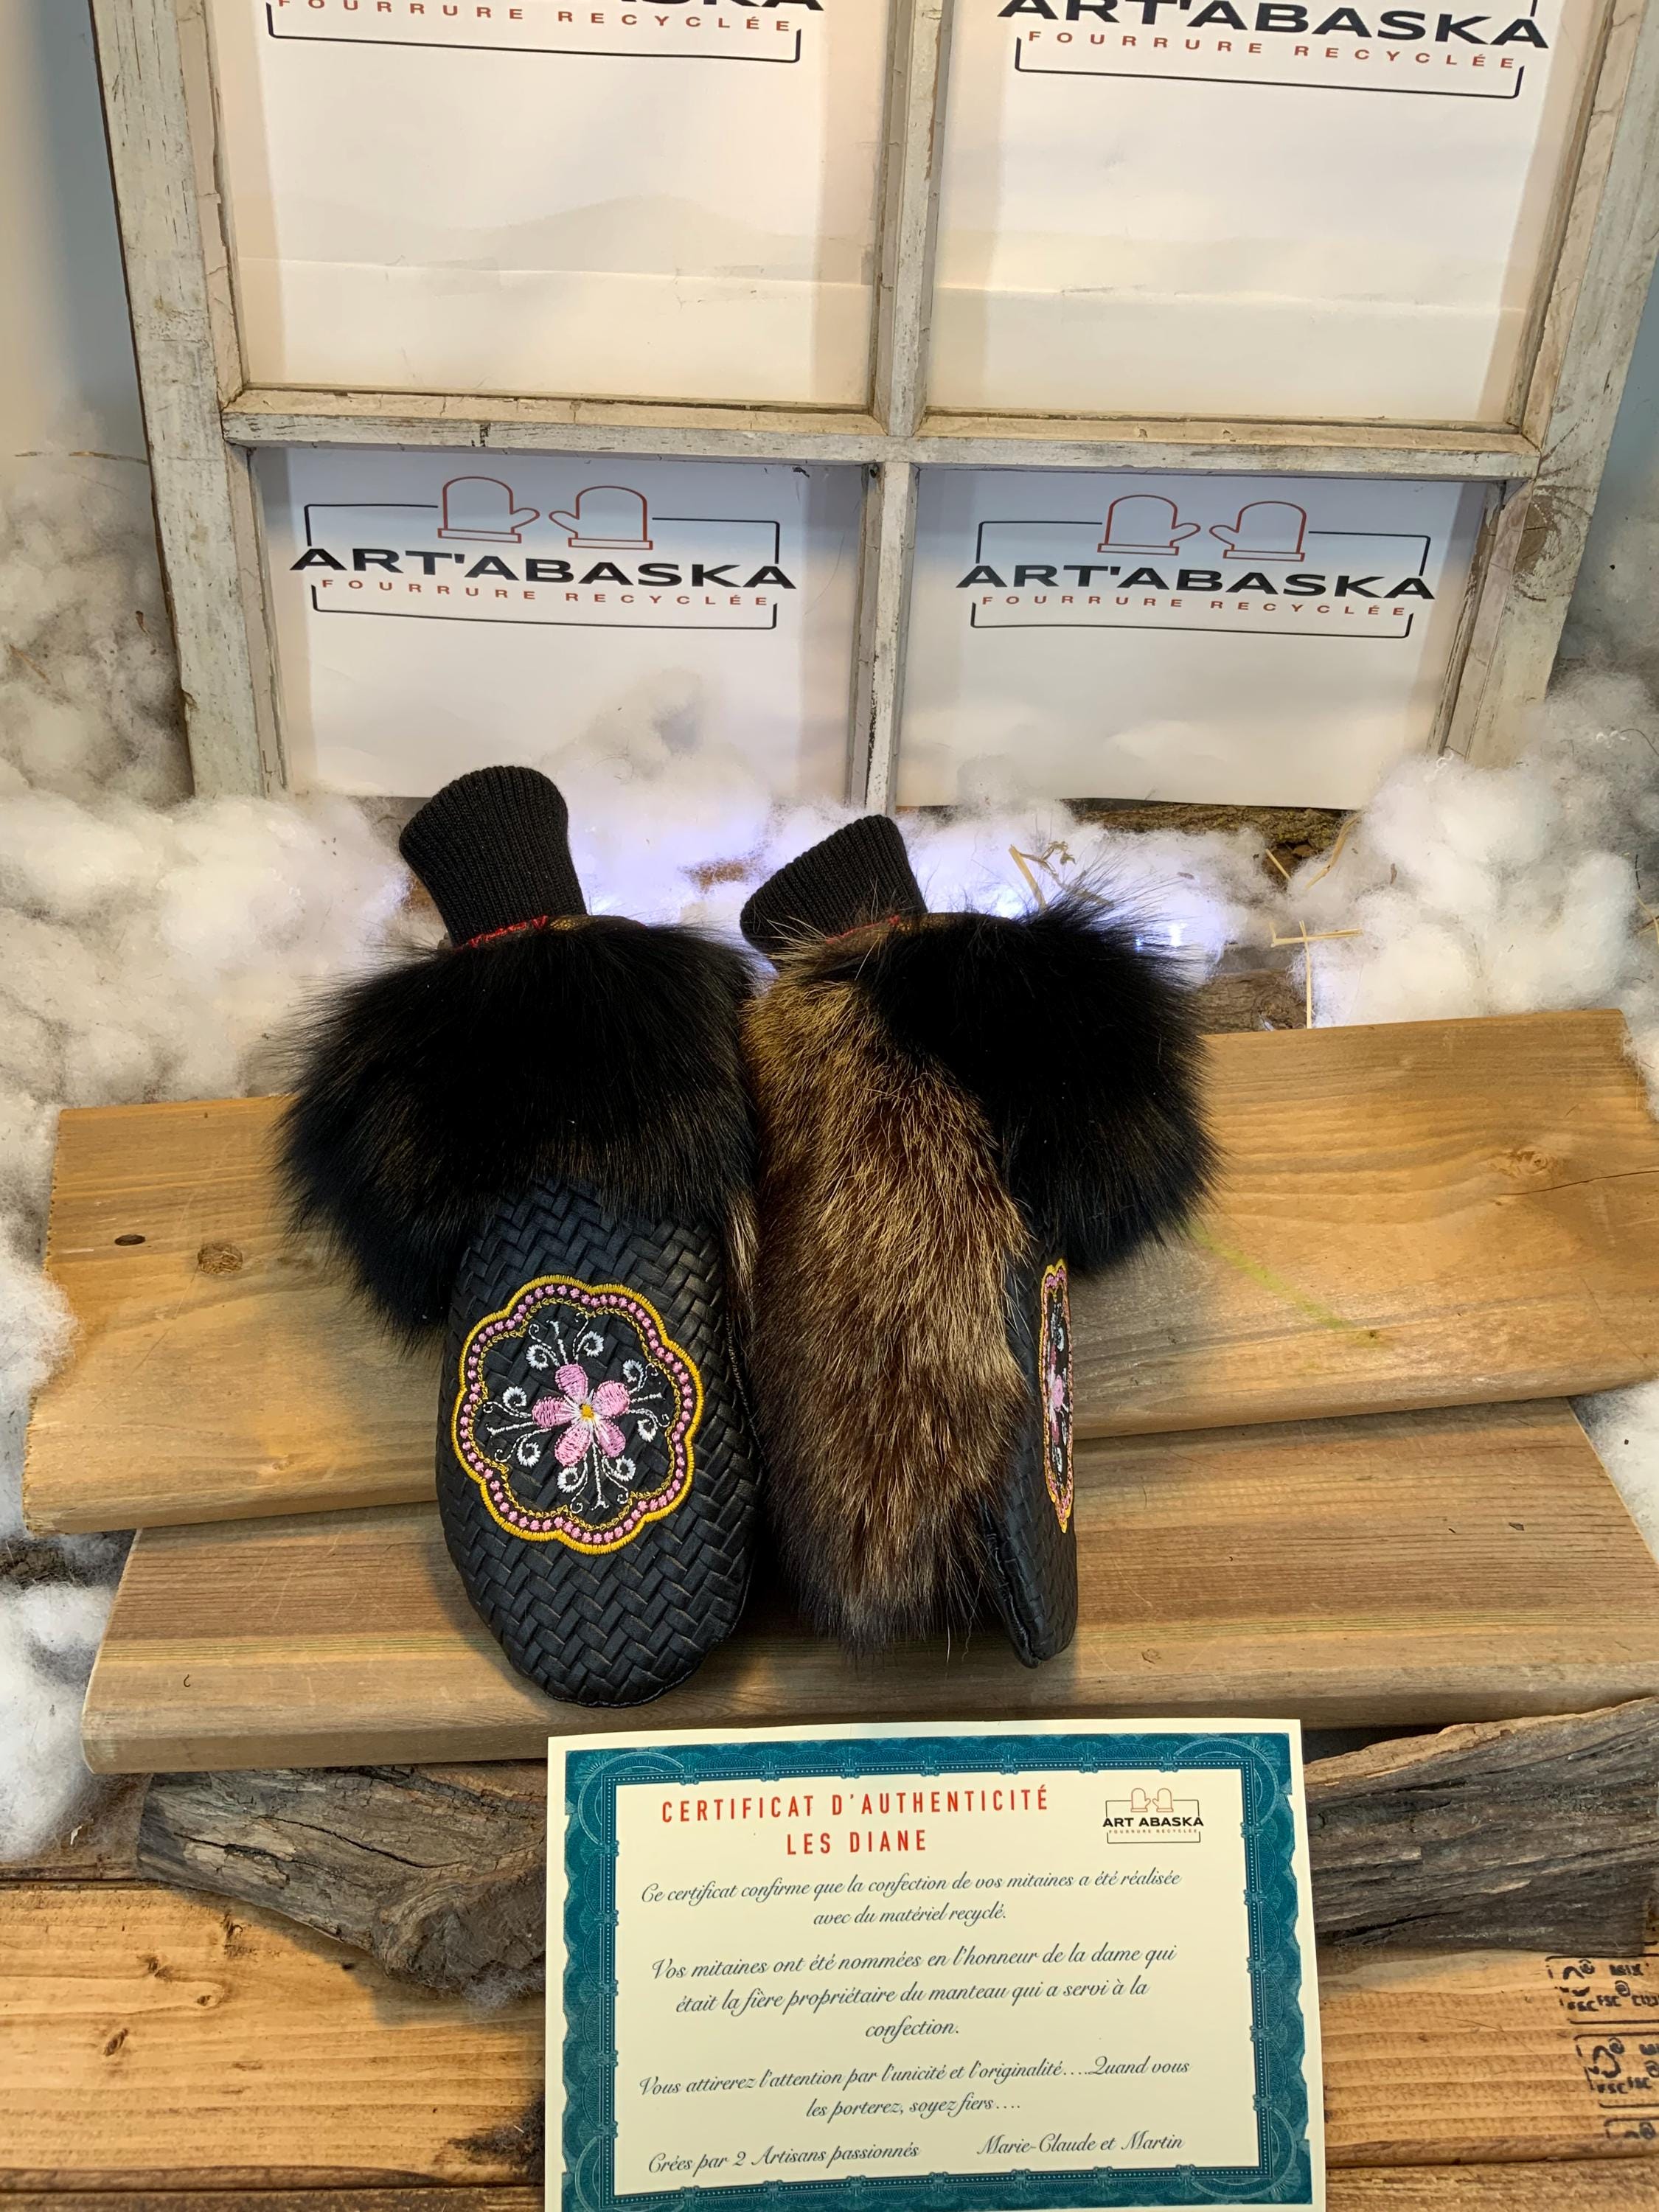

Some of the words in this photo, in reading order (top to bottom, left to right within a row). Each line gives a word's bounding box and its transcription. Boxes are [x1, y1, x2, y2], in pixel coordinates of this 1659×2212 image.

[557, 10, 790, 32] RECYCLÉE
[997, 0, 1549, 49] ART'ABASKA
[1029, 30, 1262, 54] FOURRURE
[1294, 46, 1514, 69] RECYCLÉE
[289, 547, 797, 590] ART'ABASKA
[956, 565, 1436, 600] ART'ABASKA
[322, 579, 535, 600] FOURRURE
[566, 591, 768, 606] RECYCLÉE
[982, 595, 1183, 608] FOURRURE
[1211, 601, 1405, 616] RECYCLÉE
[662, 1795, 813, 1823] CERTIFICAT
[832, 1784, 1047, 1815] D'AUTHENTICITÉ
[1102, 1818, 1134, 1827] ART
[1138, 1817, 1204, 1827] ABASKA
[787, 1832, 831, 1855] LES
[850, 1829, 926, 1853] DIANE
[641, 1883, 664, 1902] Ce
[668, 1881, 737, 1906] certificat
[741, 1877, 810, 1902] confirme
[813, 1882, 844, 1902] que
[847, 1874, 864, 1893] la
[868, 1873, 947, 1898] confection
[952, 1871, 970, 1890] de
[975, 1875, 1003, 1888] vos
[1006, 1872, 1074, 1888] mitaines
[1079, 1875, 1091, 1887] a
[1095, 1871, 1119, 1886] été
[1120, 1867, 1180, 1885] réalisée
[813, 1913, 852, 1925] avec
[854, 1905, 877, 1924] du
[879, 1902, 949, 1923] matériel
[948, 1901, 1006, 1927] recyclé.
[652, 1958, 686, 1979] Vos
[691, 1958, 768, 1978] mitaines
[773, 1957, 805, 1973] ont
[809, 1953, 836, 1972] été
[838, 1951, 922, 1970] nommées
[928, 1955, 948, 1967] en
[953, 1945, 1039, 1966] l'honneur
[1042, 1943, 1065, 1964] de
[1068, 1942, 1087, 1963] la
[1091, 1941, 1142, 1962] dame
[1145, 1944, 1178, 1969] qui
[675, 1994, 718, 2013] était
[721, 1989, 740, 2011] la
[731, 1988, 785, 2017] fière
[782, 1987, 897, 2015] propriétaire
[900, 1981, 924, 2002] du
[928, 1984, 1007, 2001] manteau
[1012, 1981, 1044, 2006] qui
[1046, 1985, 1060, 1997] a
[1063, 1980, 1110, 1997] servi
[1112, 1978, 1126, 1996] à
[1129, 1975, 1150, 1995] la
[865, 2015, 959, 2044] confection.
[639, 2076, 681, 2096] Vous
[686, 2076, 757, 2093] attirerez
[759, 2069, 844, 2089] l'attention
[843, 2068, 878, 2091] par
[882, 2063, 948, 2083] l'unicité
[950, 2067, 964, 2079] et
[1152, 2062, 1191, 2074] vous
[807, 2098, 827, 2117] les
[827, 2101, 904, 2124] porterez,
[909, 2100, 957, 2119] soyez
[976, 2132, 1097, 2155] Marie-Claude
[1099, 2137, 1116, 2151] et
[1121, 2129, 1186, 2152] Martin
[648, 2152, 693, 2174] Crées
[692, 2154, 728, 2177] par
[734, 2152, 747, 2166] 2
[751, 2146, 827, 2166] Artisans
[827, 2142, 920, 2168] passionnés
